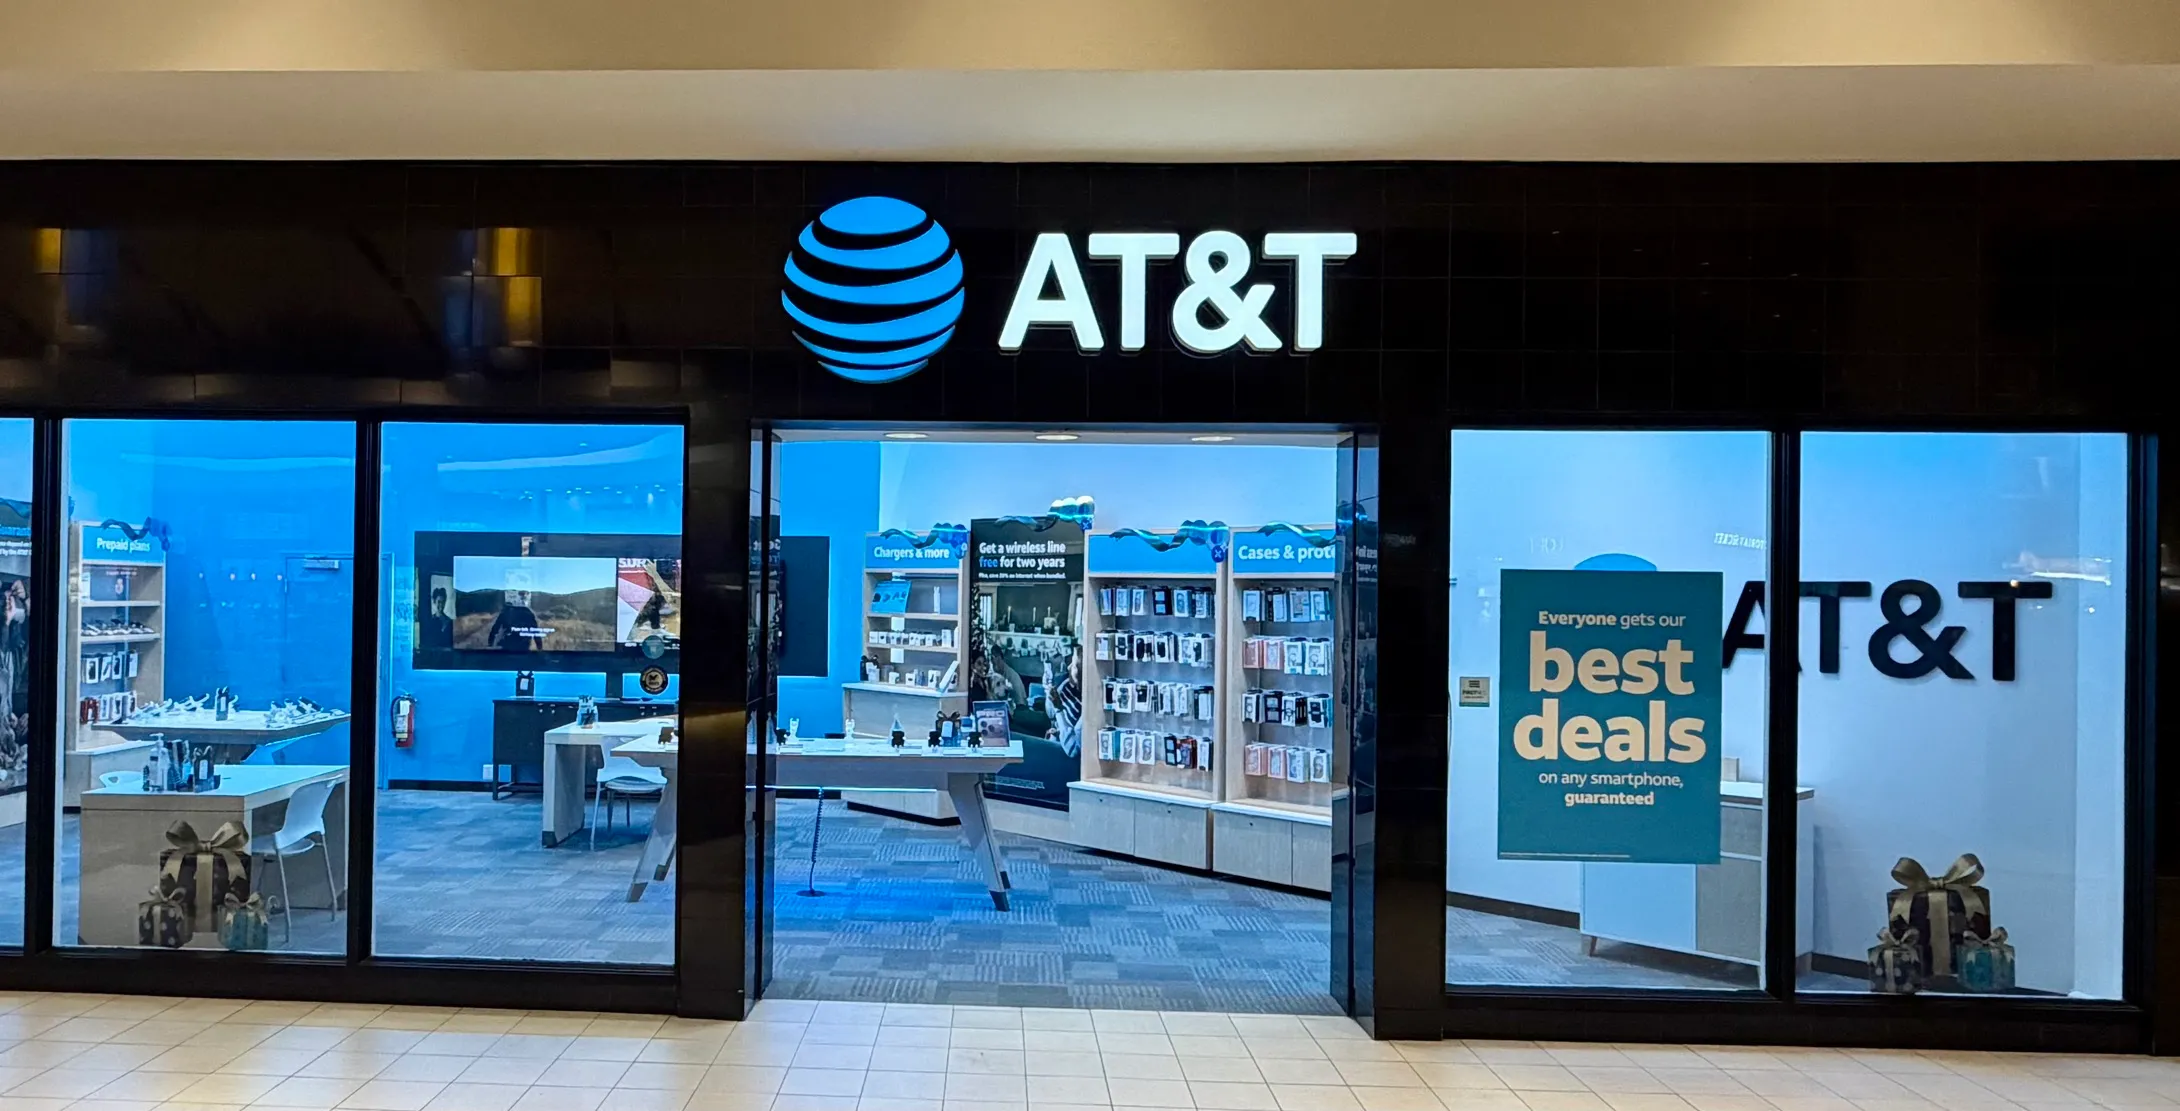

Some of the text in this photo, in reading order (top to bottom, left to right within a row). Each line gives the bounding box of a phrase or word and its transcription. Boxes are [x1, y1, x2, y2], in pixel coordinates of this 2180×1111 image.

[998, 230, 1357, 354] AT&T
[97, 537, 150, 553] Prepaid plans
[874, 546, 950, 560] Chargers & more
[979, 541, 1066, 554] Get a wireless line
[1238, 545, 1280, 560] Cases
[1283, 545, 1295, 559] &
[979, 555, 1065, 570] free for two years
[1538, 610, 1686, 630] Everyone gets our
[1722, 578, 2053, 682] AT&T
[1529, 630, 1695, 695] best
[1513, 698, 1706, 763] deals
[1538, 771, 1684, 788] on any smartphone,
[1564, 791, 1655, 807] guaranteed
